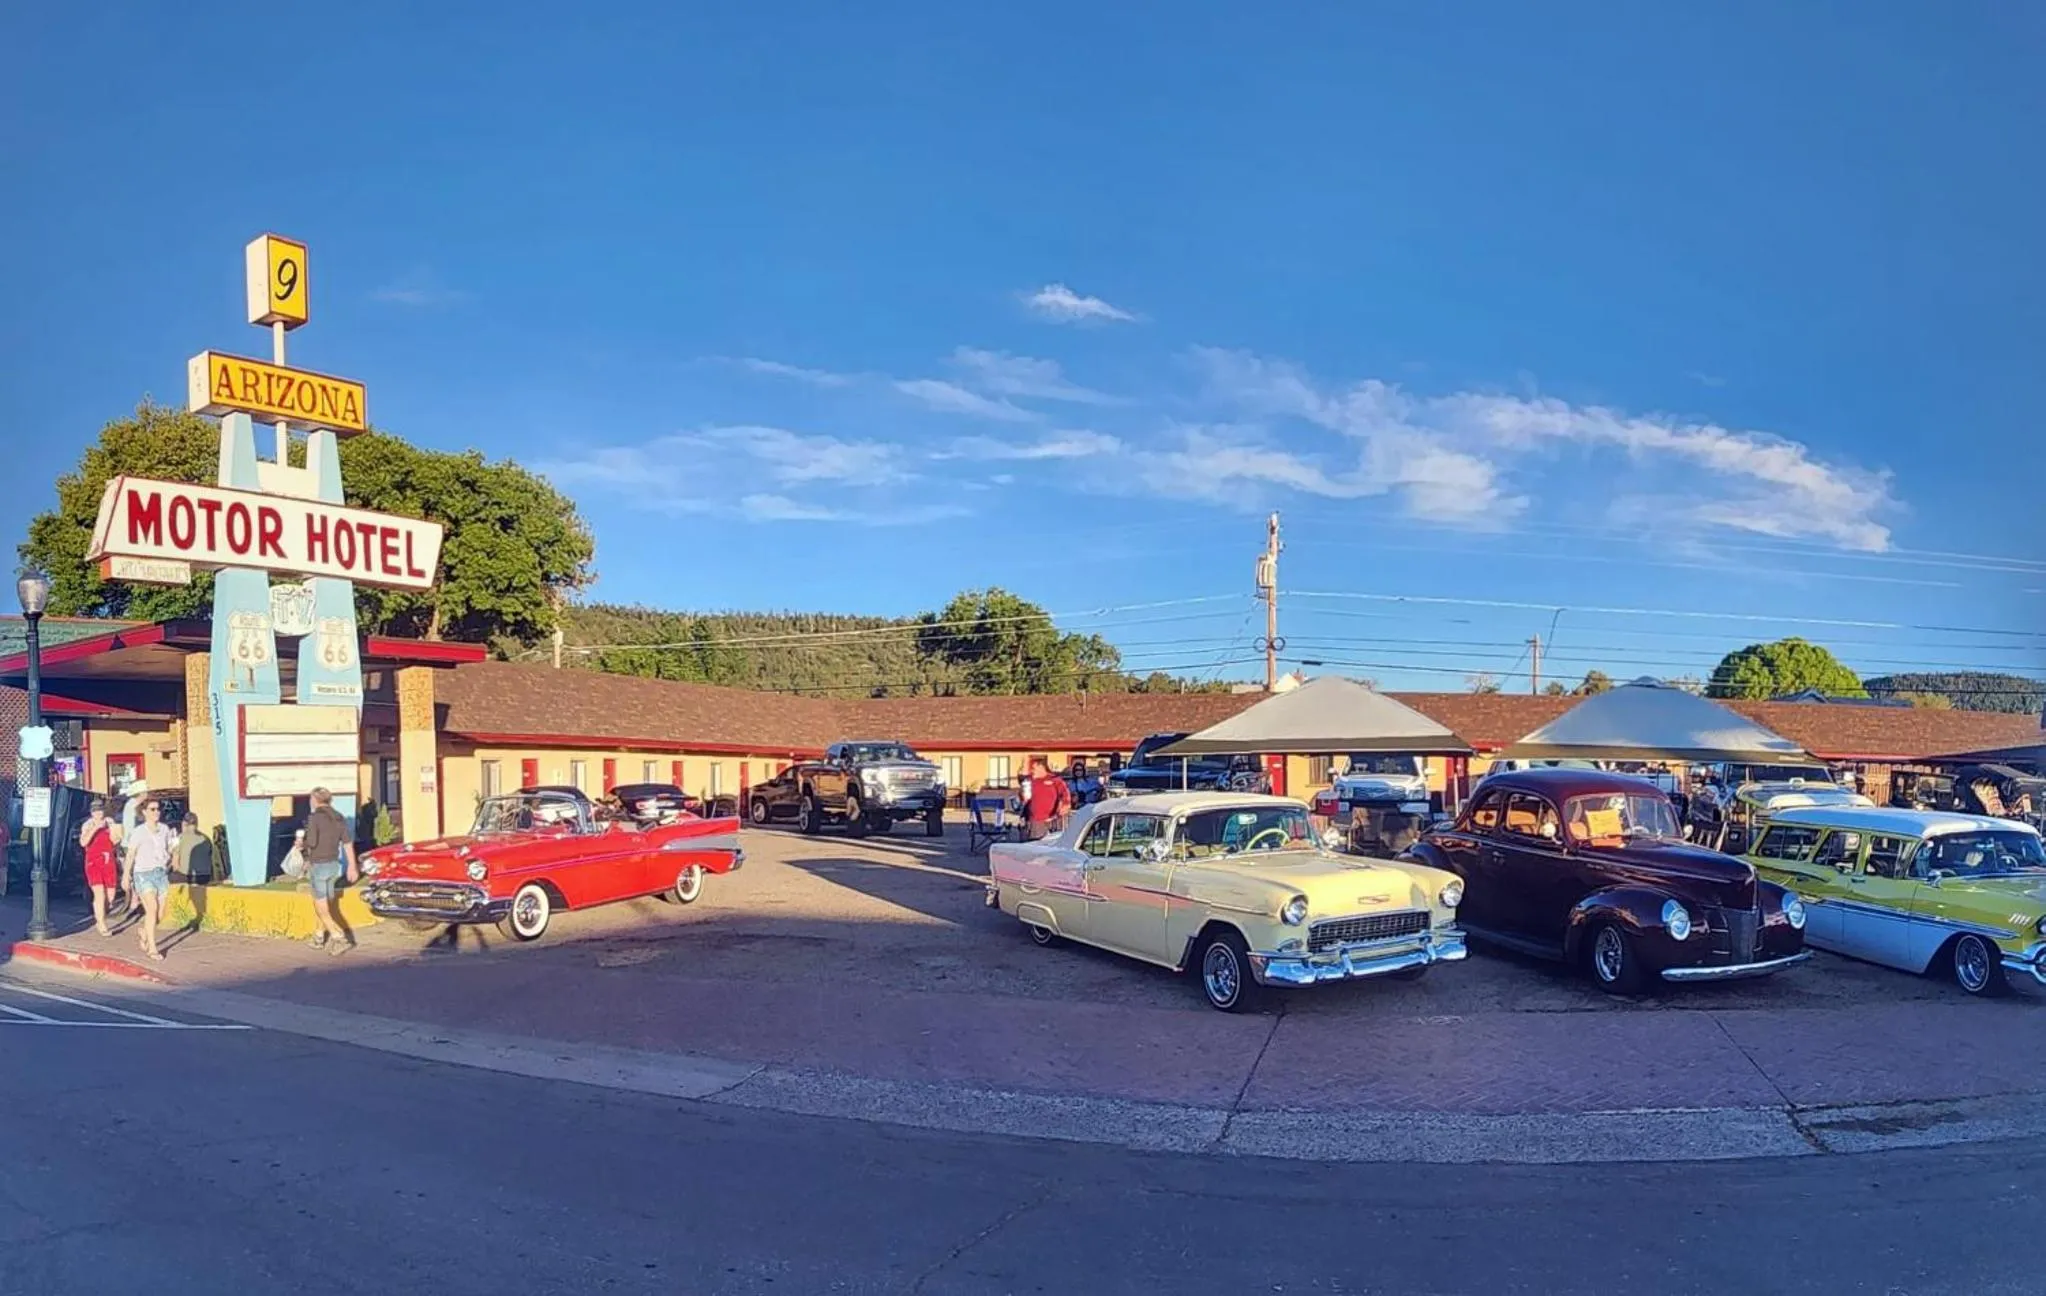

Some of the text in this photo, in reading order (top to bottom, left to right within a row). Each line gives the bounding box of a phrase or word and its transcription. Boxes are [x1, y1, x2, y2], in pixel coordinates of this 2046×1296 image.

[274, 258, 298, 301] 9
[214, 363, 361, 425] ARIZONA
[127, 489, 426, 578] MOTOR HOTEL
[238, 639, 266, 660] 66
[324, 643, 348, 664] 66
[212, 692, 222, 736] 315
